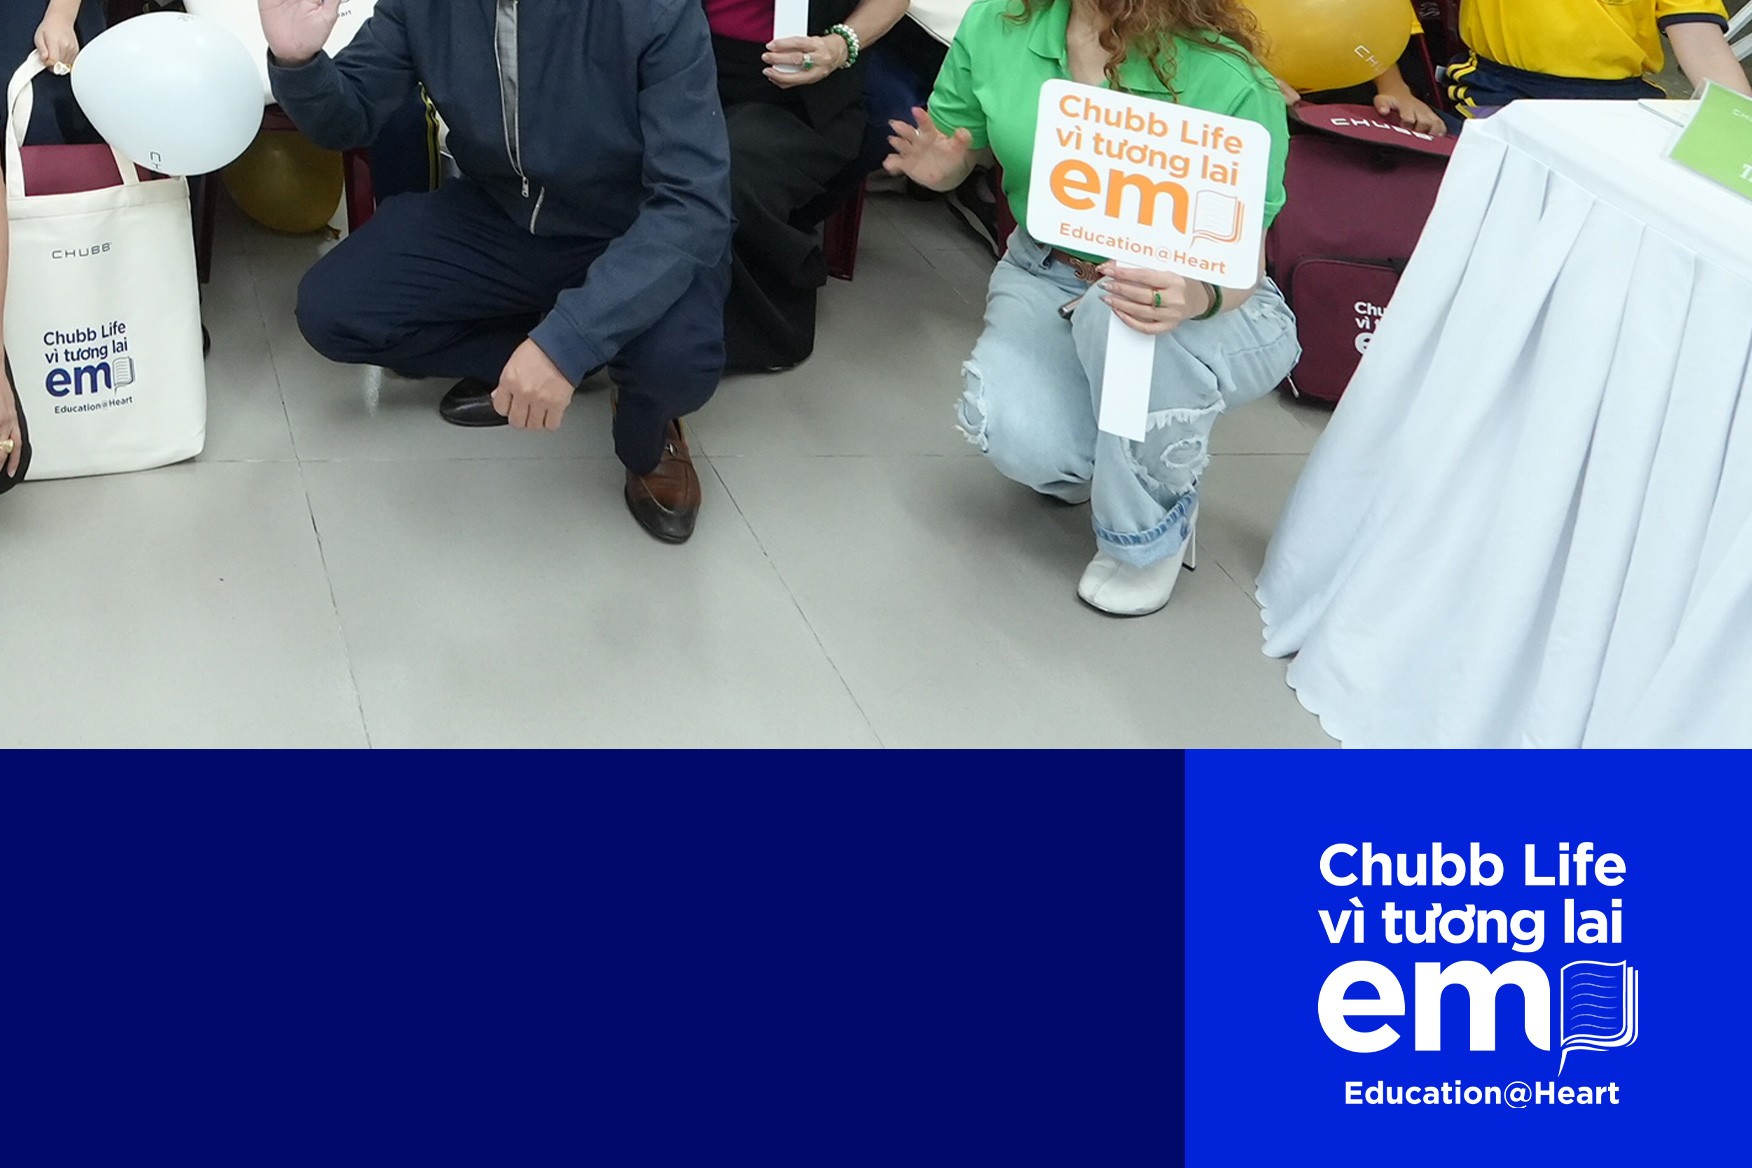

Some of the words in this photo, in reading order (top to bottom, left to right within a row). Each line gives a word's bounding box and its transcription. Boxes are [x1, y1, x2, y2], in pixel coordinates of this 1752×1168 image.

[1058, 94, 1169, 138] Chubb
[1180, 119, 1244, 154] Life
[1056, 125, 1083, 150] vì
[1093, 131, 1191, 179] tương
[1201, 155, 1239, 186] lai
[1049, 159, 1190, 235] em
[52, 243, 111, 259] CHUBB
[1059, 222, 1227, 274] Education@Heart
[1354, 301, 1385, 317] Chu
[1355, 316, 1370, 329] vì
[44, 327, 96, 346] Chubb
[102, 321, 126, 338] Life
[45, 348, 59, 364] vì
[64, 344, 108, 362] tương
[112, 337, 128, 354] lai
[45, 361, 112, 398] em
[54, 396, 133, 414] Education@Heart
